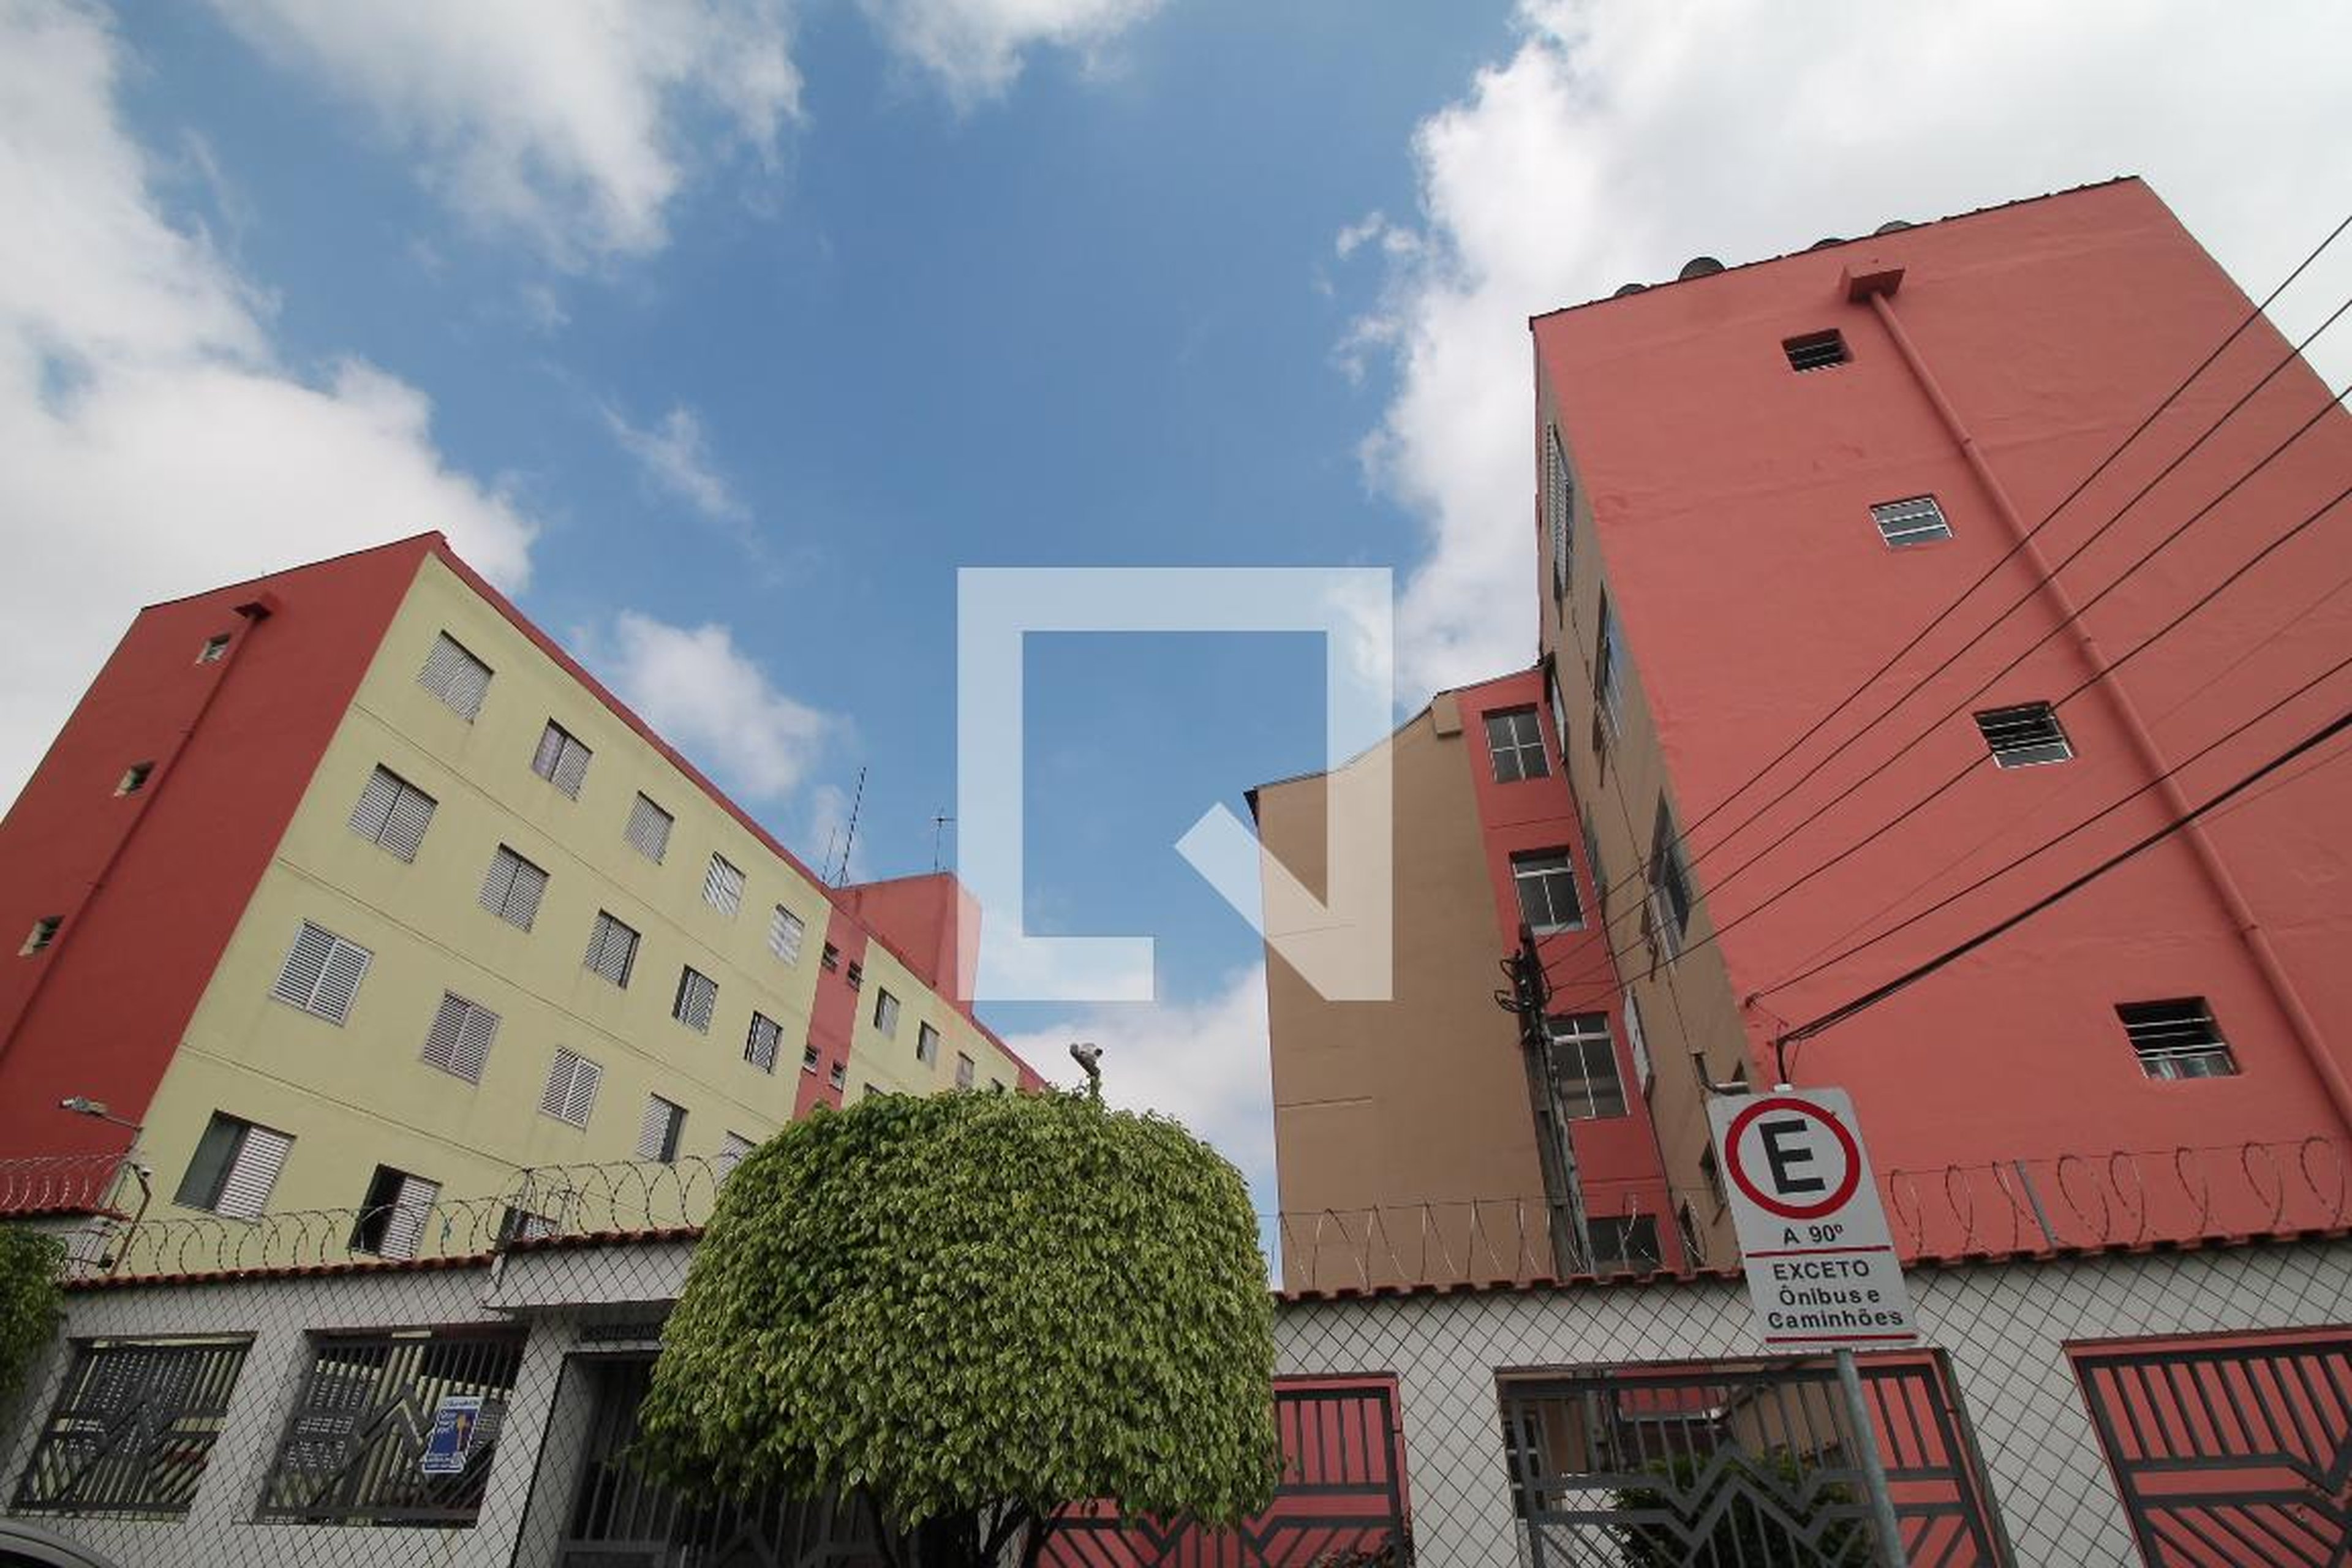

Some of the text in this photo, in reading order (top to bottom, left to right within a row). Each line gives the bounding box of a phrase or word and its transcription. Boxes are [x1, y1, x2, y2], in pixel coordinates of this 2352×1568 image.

[1759, 1119, 1825, 1194] E
[1784, 1227, 1800, 1245] A
[1773, 1261, 1869, 1280] EXCETO
[1779, 1284, 1880, 1305] Ônibus e
[1768, 1308, 1904, 1329] Caminhões
